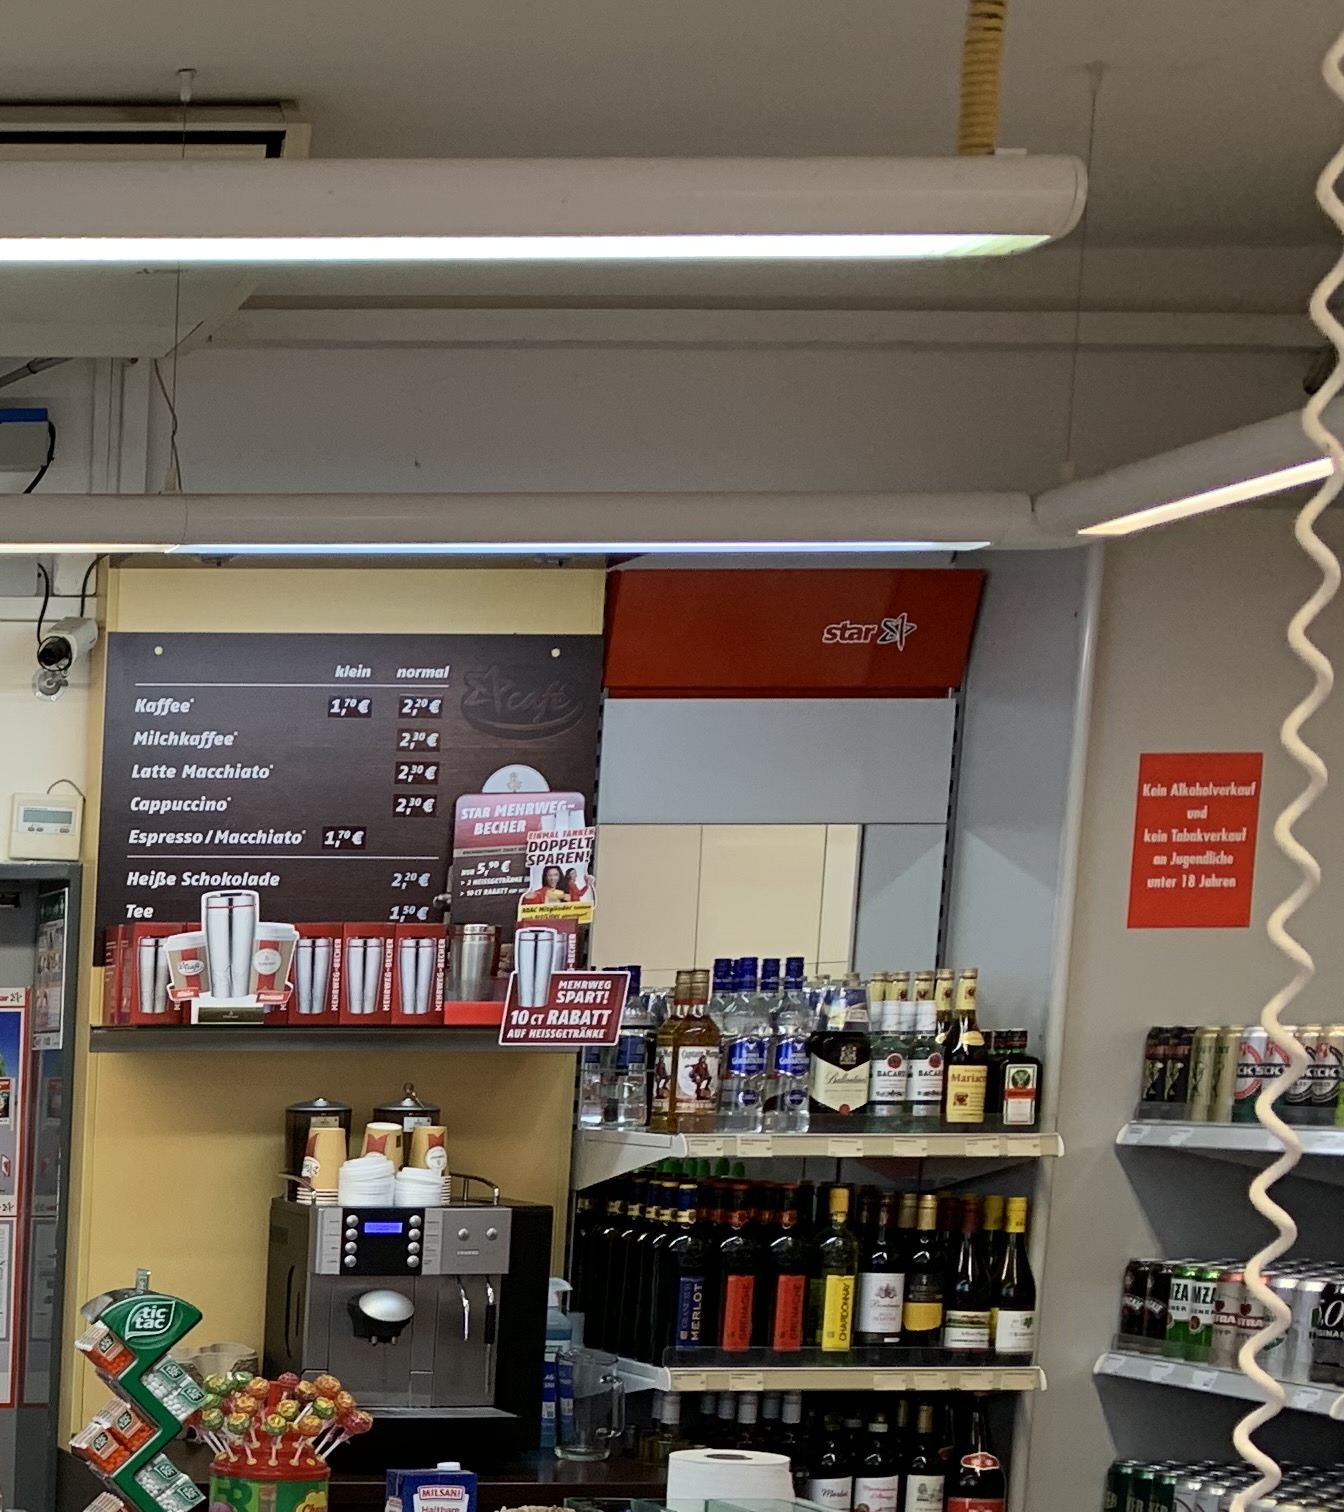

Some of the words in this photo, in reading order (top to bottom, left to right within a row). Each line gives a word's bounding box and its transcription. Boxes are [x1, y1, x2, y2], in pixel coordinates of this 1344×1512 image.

[822, 619, 877, 644] star
[335, 665, 371, 679] klein
[397, 665, 449, 679] normal
[131, 764, 176, 779] Latte
[1143, 784, 1167, 797] Kein
[1170, 782, 1256, 796] Alkoholverkauf
[462, 807, 490, 819] STAR
[1187, 805, 1208, 819] und
[474, 820, 526, 835] BECHER
[1144, 829, 1167, 842] kein
[1172, 827, 1247, 842] Tabakverkauf
[529, 837, 592, 853] DOPPELT
[527, 852, 590, 866] SPAREN!
[1153, 855, 1167, 865] an
[1170, 851, 1233, 868] Jugendliche
[127, 872, 176, 887] Heiße
[181, 872, 279, 887] Schokolade
[1147, 876, 1176, 888] unter
[1182, 875, 1195, 887] 18
[1199, 874, 1236, 887] Jahren
[126, 905, 153, 918] Tee
[435, 939, 445, 1011] MEHRWEG-BECHER
[558, 981, 611, 989] MEHRWEG
[556, 991, 609, 1004] SPART!
[511, 1010, 529, 1024] 10
[531, 1014, 544, 1024] CT
[546, 1010, 612, 1025] RABATT
[507, 1030, 526, 1038] AUF
[529, 1027, 606, 1038] HEISSGETRÄNKE
[140, 1304, 165, 1318] tic
[690, 1283, 702, 1340] MERLOT
[839, 1282, 850, 1341] CHARDONNAY
[136, 1317, 166, 1330] tac
[420, 1486, 462, 1500] MILSANI
